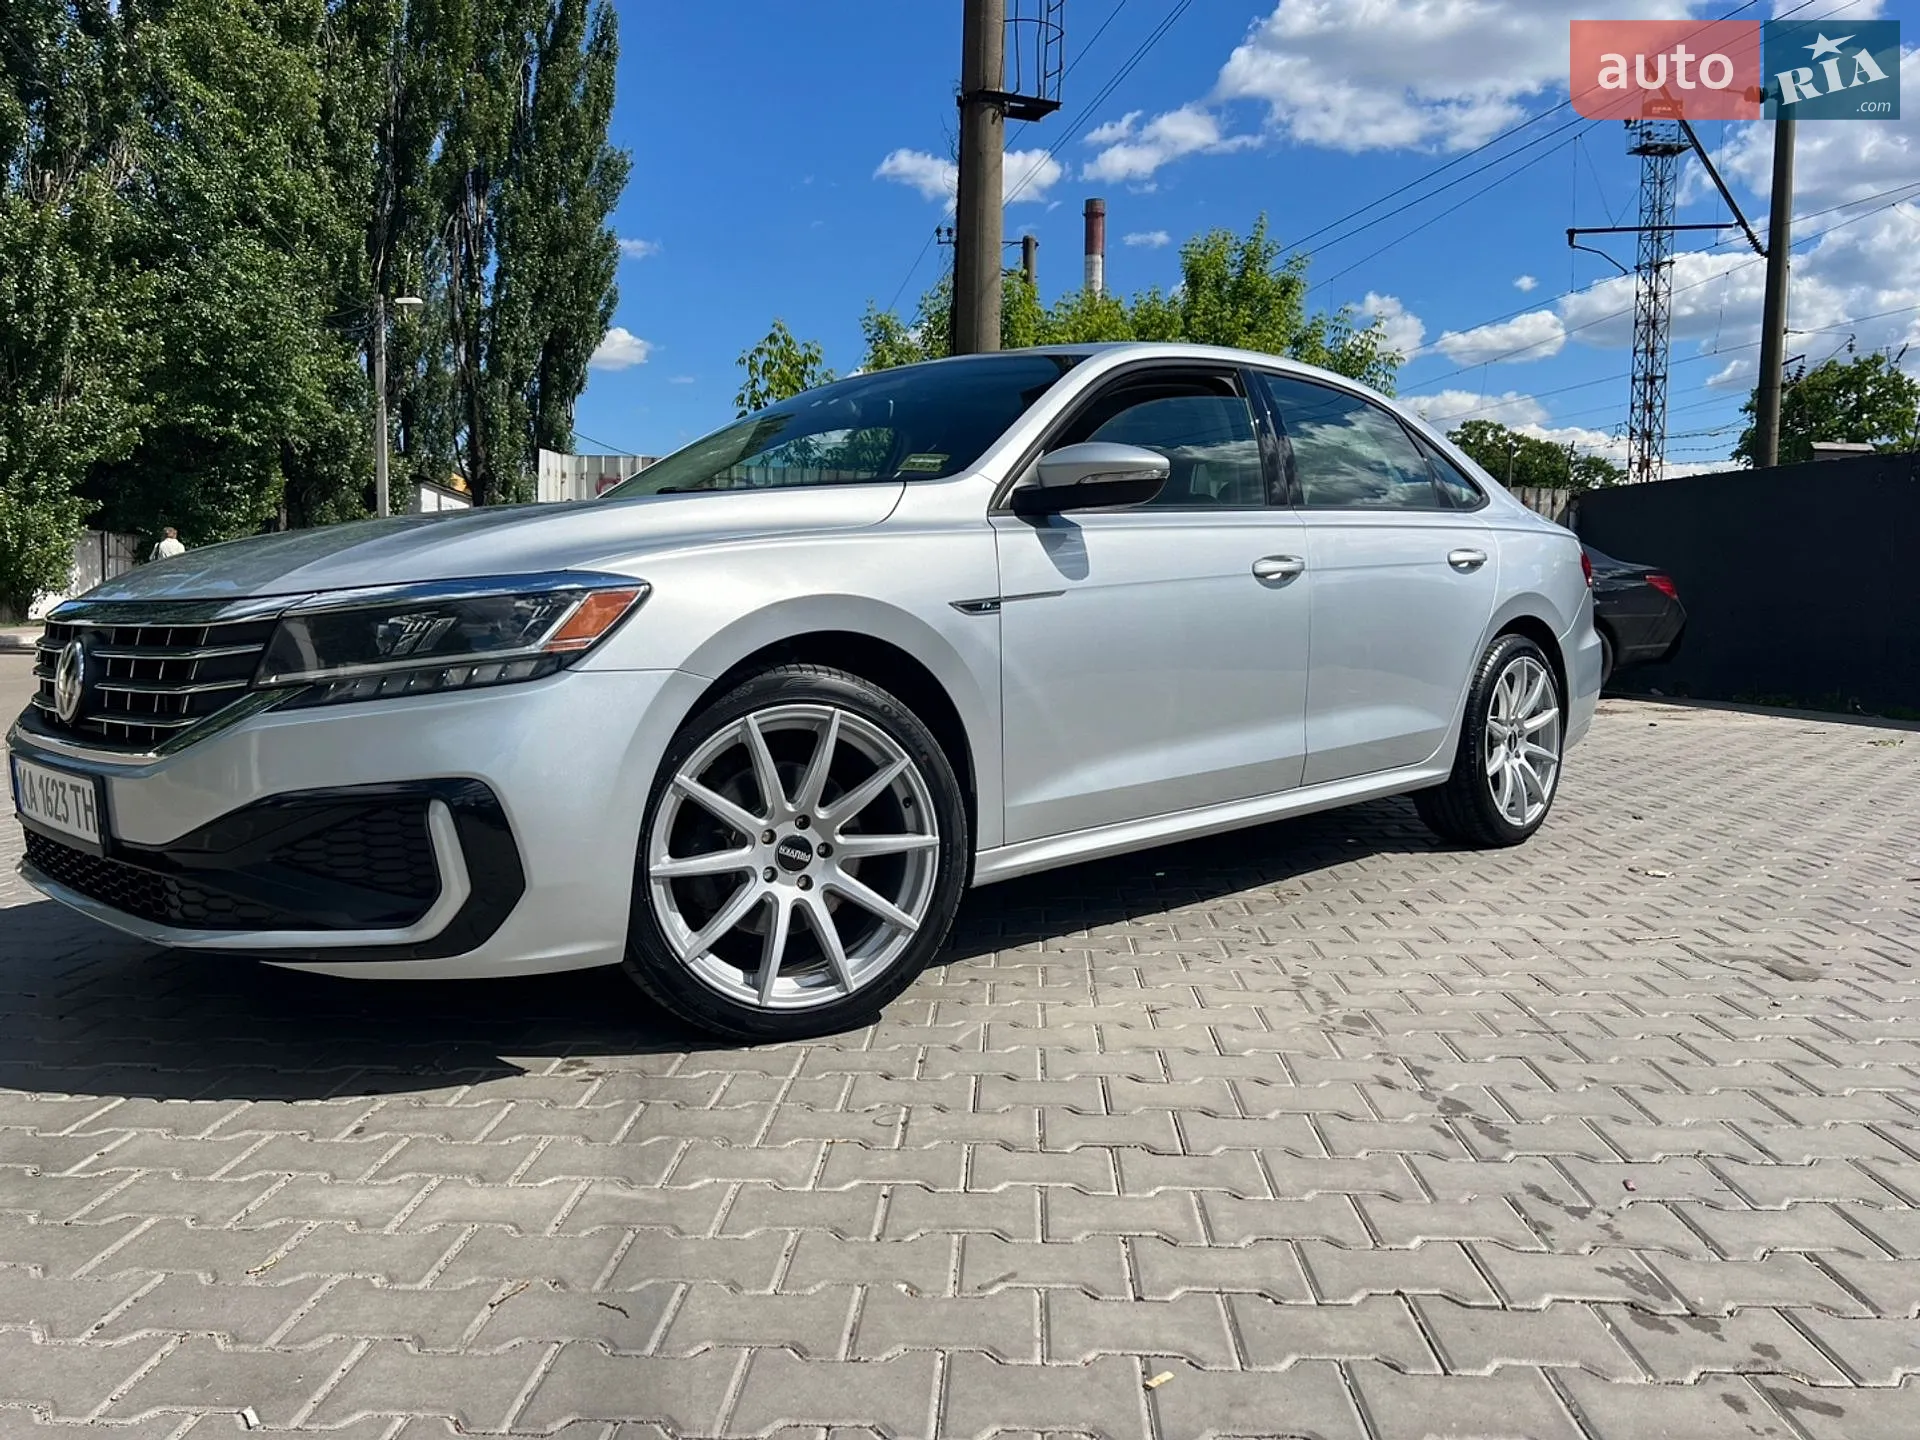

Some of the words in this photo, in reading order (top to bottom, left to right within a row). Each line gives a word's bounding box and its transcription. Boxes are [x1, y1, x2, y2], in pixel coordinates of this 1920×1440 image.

[18, 766, 39, 813] KA
[39, 774, 69, 825] 1623
[70, 783, 97, 834] TH
